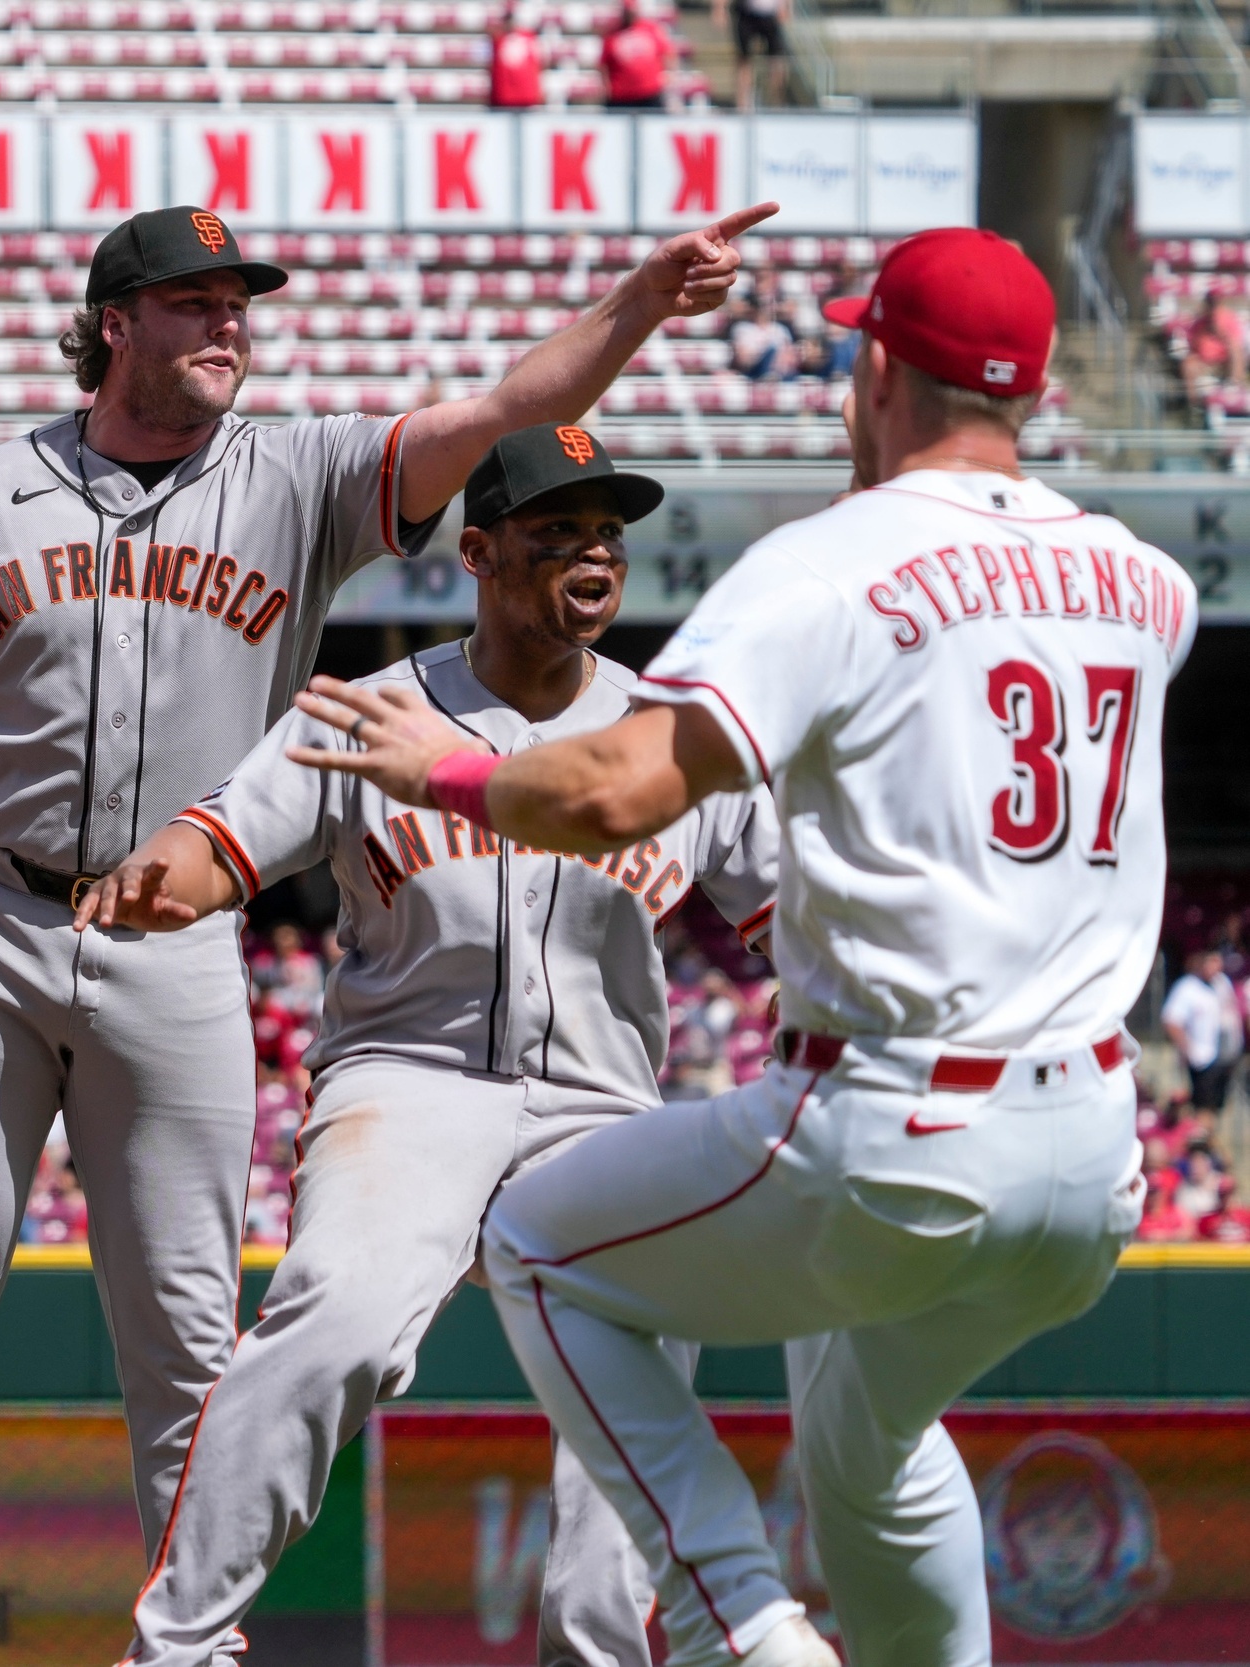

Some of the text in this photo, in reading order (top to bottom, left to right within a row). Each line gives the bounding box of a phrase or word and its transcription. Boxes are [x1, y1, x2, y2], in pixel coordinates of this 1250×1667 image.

[433, 130, 481, 210] K
[551, 131, 597, 211] K
[40, 537, 289, 645] FRANCISCO
[864, 543, 1188, 657] STEPHENSON
[982, 655, 1142, 868] 37
